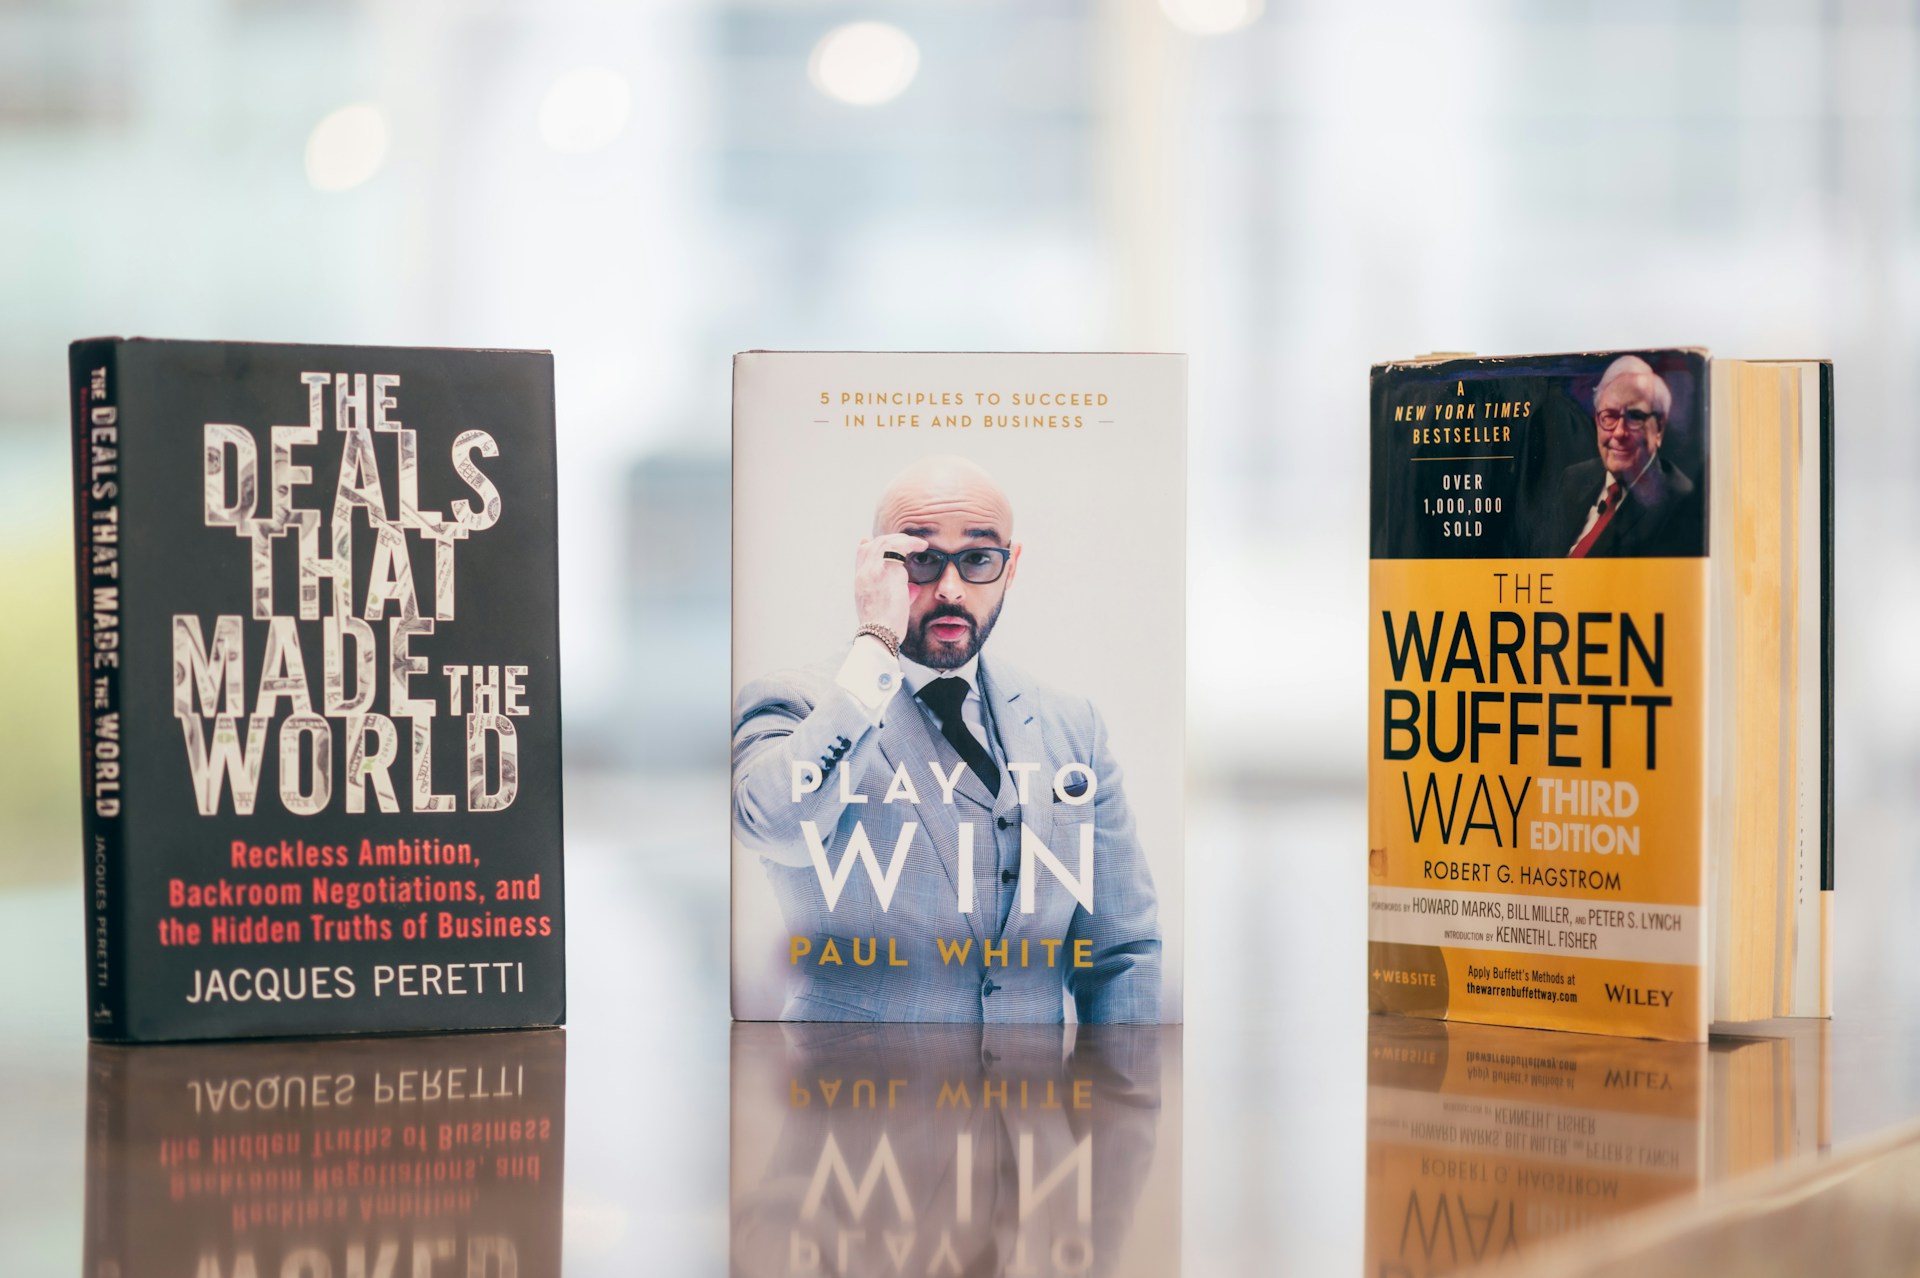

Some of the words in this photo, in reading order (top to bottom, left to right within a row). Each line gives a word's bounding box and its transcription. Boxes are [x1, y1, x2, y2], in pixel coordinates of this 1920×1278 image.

[91, 366, 106, 400] THE
[820, 392, 830, 405] 5
[841, 392, 964, 405] PRINCIPLES
[975, 393, 1000, 405] TO
[1012, 393, 1108, 406] SUCCEED
[1457, 381, 1464, 396] A
[301, 372, 400, 431] THE
[1395, 405, 1426, 422] NEW
[1435, 403, 1475, 420] YORK
[1484, 401, 1531, 419] TIMES
[845, 415, 864, 427] IN
[877, 415, 920, 427] LIFE
[931, 415, 972, 428] AND
[984, 416, 1083, 428] BUSINESS
[1413, 426, 1511, 445] BESTSELLER
[91, 406, 118, 500] DEALS
[204, 423, 501, 531] DEALS
[1443, 474, 1483, 490] OVER
[1424, 497, 1502, 515] 1,000,000
[92, 506, 118, 578] THAT
[1443, 521, 1483, 537] SOLD
[236, 520, 469, 620] THAT
[1493, 573, 1553, 604] THE
[93, 586, 119, 668] MADE
[172, 615, 436, 717] MADE
[443, 665, 529, 715] THE
[1382, 610, 1664, 687] WARREN
[94, 676, 109, 709] THE
[1383, 689, 1672, 770] BUFFETT
[95, 712, 120, 818] WORLD
[180, 713, 518, 815] WORLD
[791, 761, 967, 805] PLAY
[1008, 762, 1097, 805] TO
[1537, 777, 1639, 818] THIRD
[1402, 771, 1532, 848] WAY
[231, 839, 349, 868] Reckless
[358, 838, 480, 868] Ambition,
[1530, 821, 1640, 855] EDITION
[95, 834, 107, 910] JACQUES
[800, 820, 1094, 915] WIN
[1424, 861, 1490, 882] ROBERT
[1497, 865, 1514, 884] G.
[1521, 867, 1621, 890] HAGSTROM
[169, 878, 301, 908] Backroom
[312, 876, 485, 909] Negotiations,
[496, 874, 541, 900] and
[158, 918, 200, 946] the
[211, 916, 300, 944] Hidden
[310, 914, 392, 942] Truths
[403, 912, 428, 940] of
[438, 911, 551, 939] Business
[1371, 901, 1401, 912] FOREWORDS
[1404, 904, 1410, 912] BY
[1412, 897, 1459, 916] HOWARD
[1461, 900, 1504, 921] MARKS,
[1507, 903, 1530, 922] BILL
[1532, 905, 1572, 926] MILLER,
[1575, 915, 1586, 926] AND
[1588, 909, 1624, 928] PETER
[1627, 912, 1638, 929] S.
[1641, 912, 1681, 931] LYNCH
[96, 917, 108, 987] PERETTI
[790, 937, 908, 966] PAUL
[937, 938, 1094, 968] WHITE
[1444, 930, 1483, 941] INTRODUCTION
[1485, 933, 1493, 941] BY
[1496, 926, 1545, 945] KENNETH
[1547, 930, 1556, 947] L.
[1559, 931, 1597, 950] FISHER
[186, 966, 356, 1003] JACQUES
[374, 962, 524, 997] PERETTI
[1467, 982, 1577, 1003] thewarrenbuffettway.com
[1468, 965, 1490, 981] Apply
[1493, 966, 1529, 982] Buffett's
[1531, 970, 1564, 985] Methods
[1567, 974, 1575, 985] at
